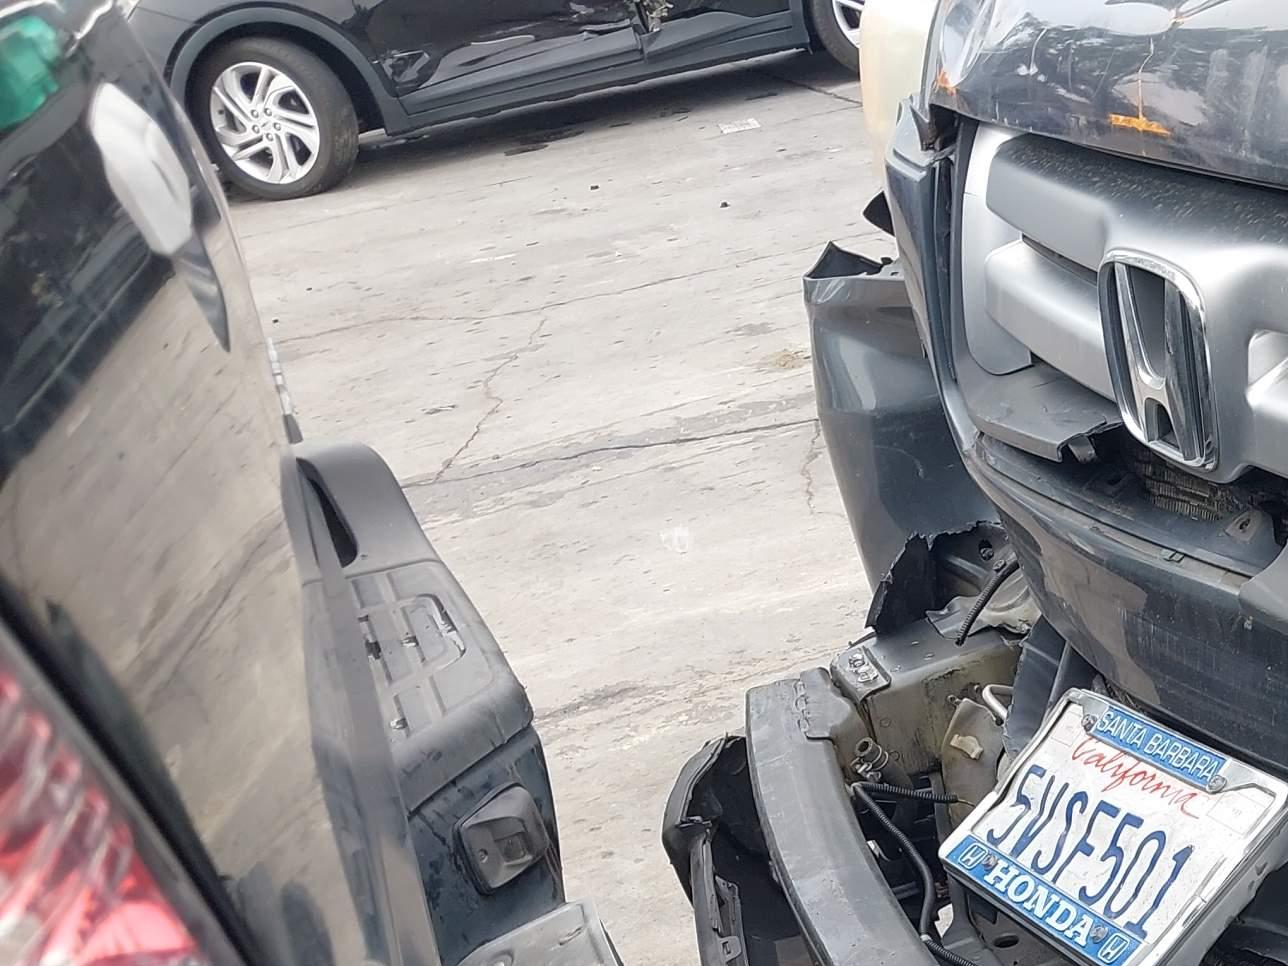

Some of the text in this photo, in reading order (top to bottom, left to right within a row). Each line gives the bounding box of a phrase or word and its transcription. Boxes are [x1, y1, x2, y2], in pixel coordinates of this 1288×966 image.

[1071, 737, 1201, 819] California
[1097, 711, 1219, 782] SANTA BARBARA
[986, 763, 1194, 938] 5VSF501
[984, 860, 1095, 947] HONDA
